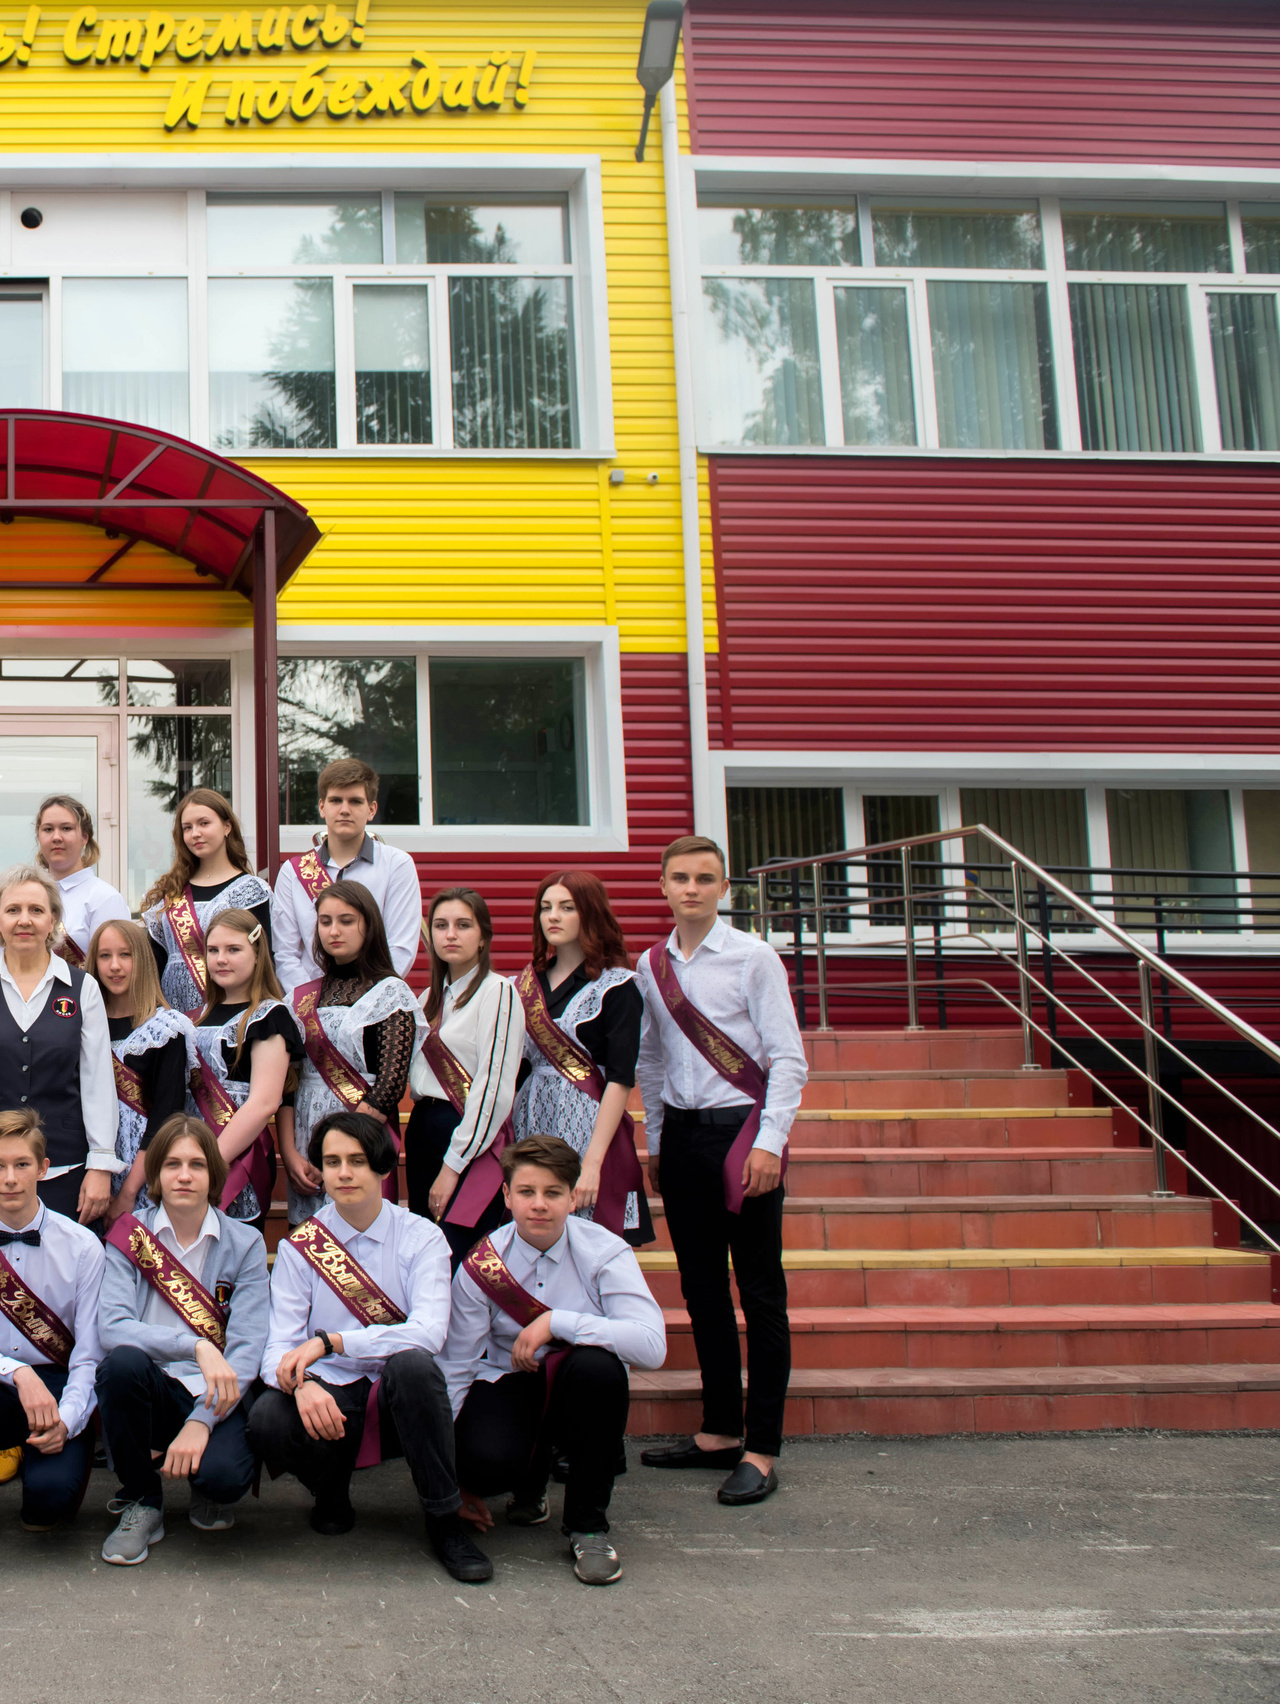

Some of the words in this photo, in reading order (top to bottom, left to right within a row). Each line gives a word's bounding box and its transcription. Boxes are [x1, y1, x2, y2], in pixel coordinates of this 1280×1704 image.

[62, 0, 371, 71] Стремись!
[164, 72, 213, 132] И
[224, 49, 538, 126] побеждай!
